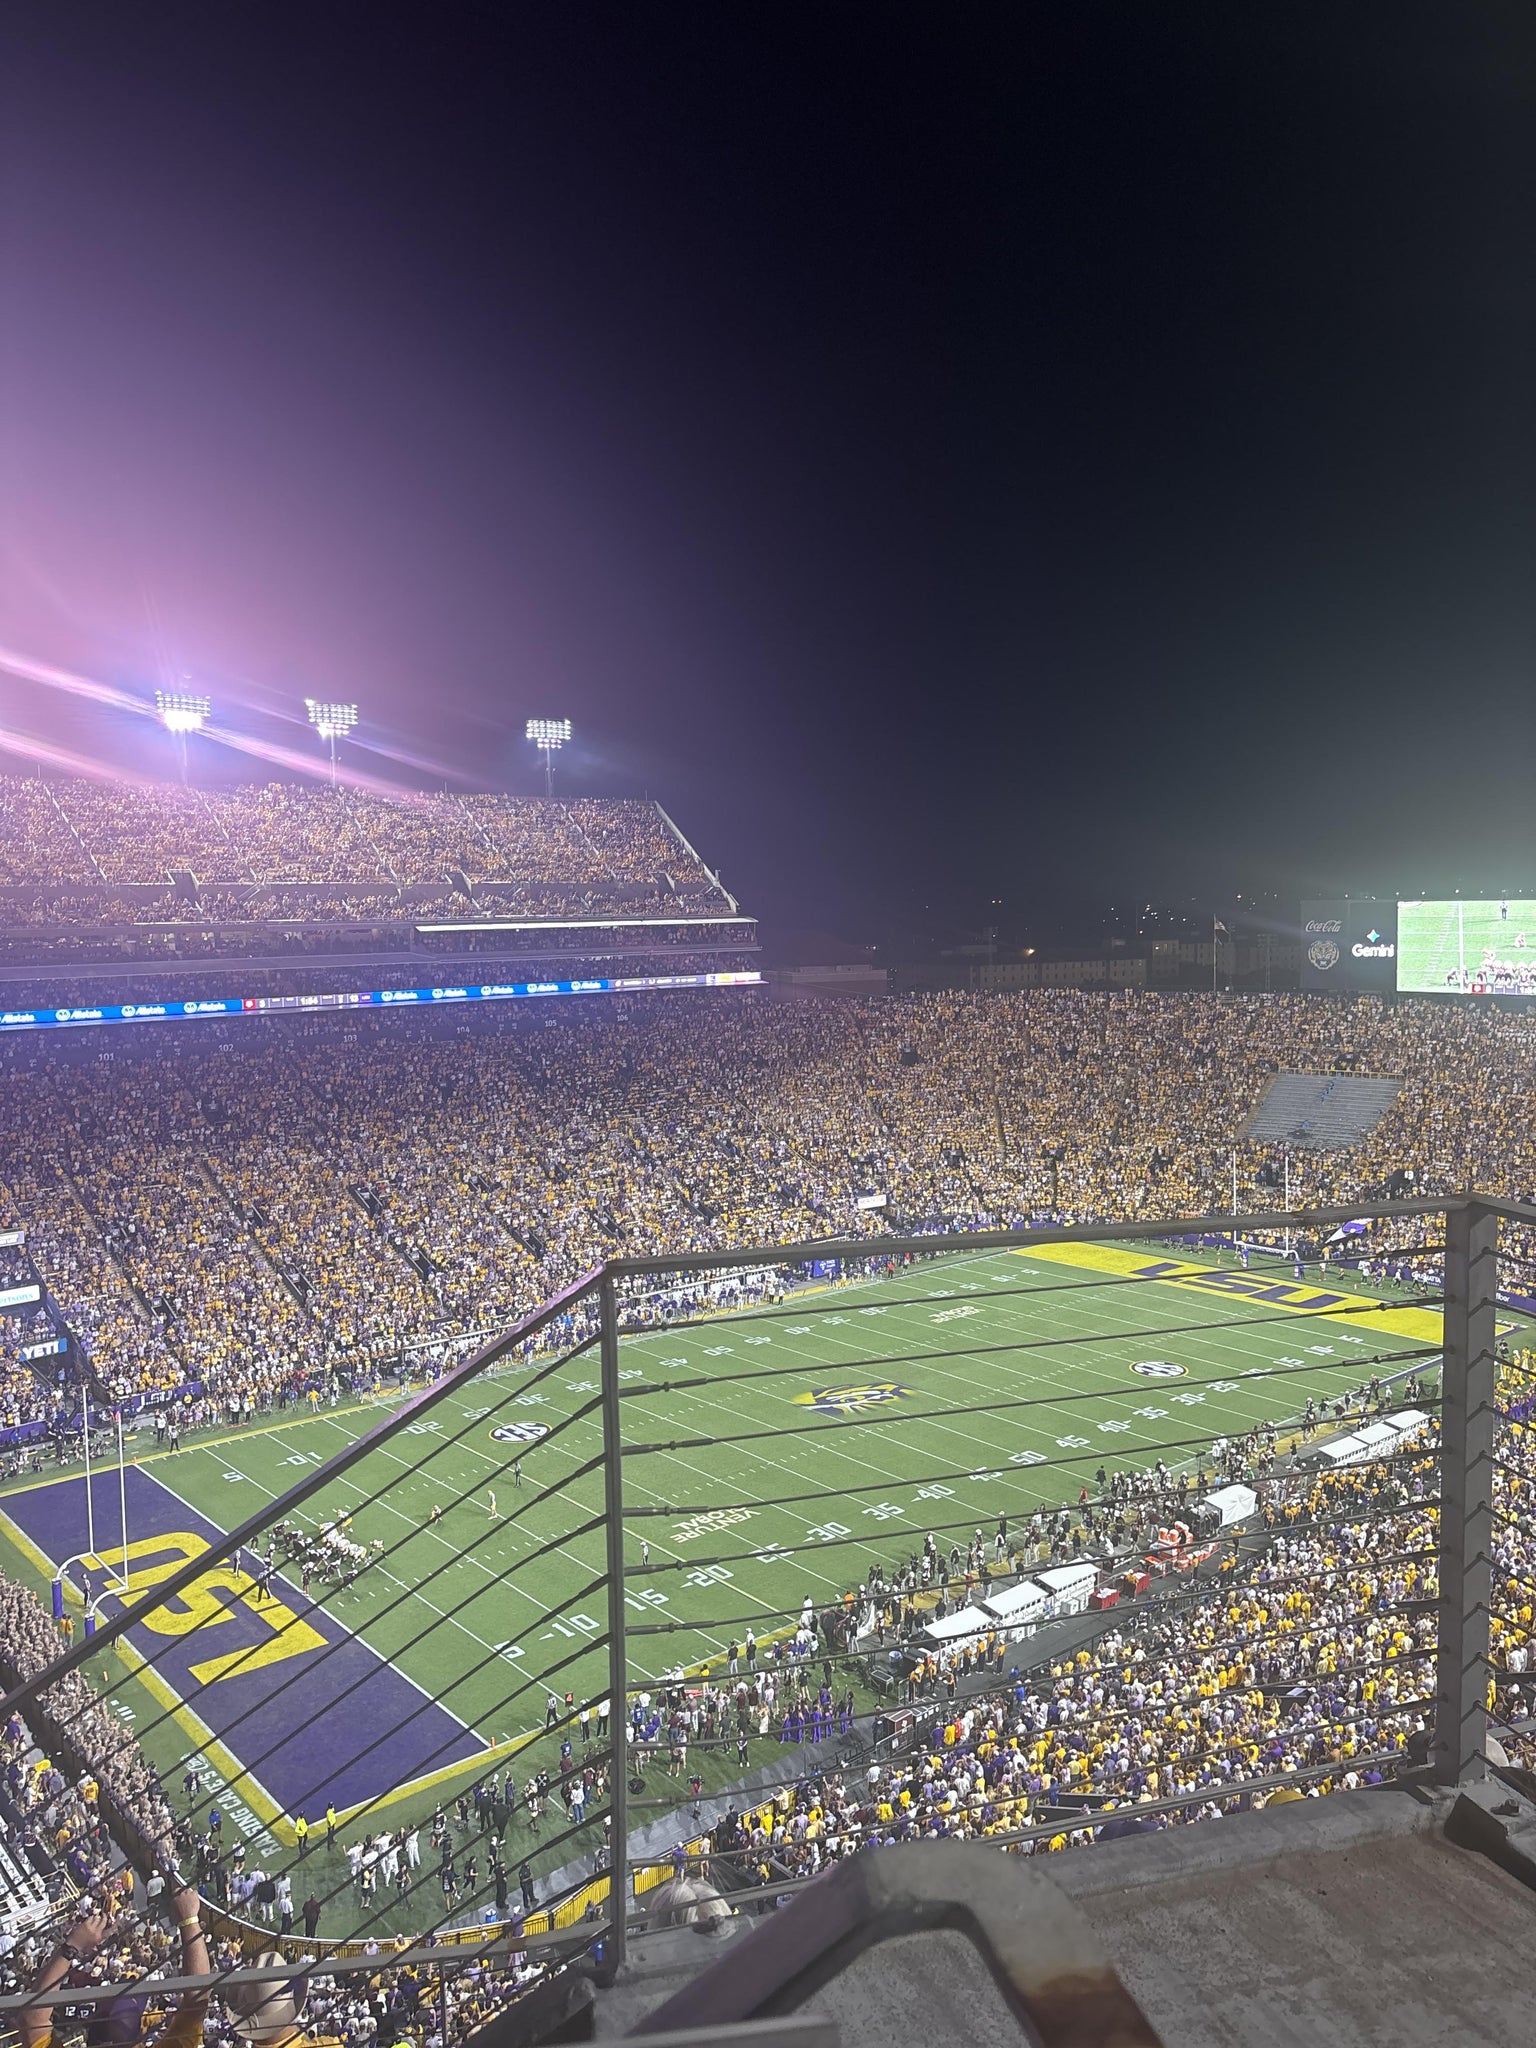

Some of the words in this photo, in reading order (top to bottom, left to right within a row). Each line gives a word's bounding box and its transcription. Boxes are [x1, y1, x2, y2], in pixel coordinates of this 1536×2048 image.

[1352, 943, 1395, 957] Gemini
[343, 1035, 358, 1043] 103
[456, 1026, 470, 1034] 104
[98, 1053, 115, 1061] 101
[218, 1044, 234, 1052] 102
[1128, 1262, 1348, 1309] LSU
[23, 1340, 59, 1360] YETI
[1056, 1435, 1091, 1448] 45
[1008, 1450, 1049, 1465] 50
[222, 1471, 244, 1483] 5
[917, 1483, 956, 1500] 40
[861, 1502, 905, 1521] 35
[670, 1509, 761, 1543] VENTURE
[806, 1522, 852, 1541] 30
[686, 1565, 734, 1587] 20
[79, 1532, 329, 1685] LSU
[624, 1588, 670, 1611] 15
[552, 1613, 600, 1638] 10
[229, 1803, 283, 1858] RAISING
[65, 2006, 76, 2017] 12
